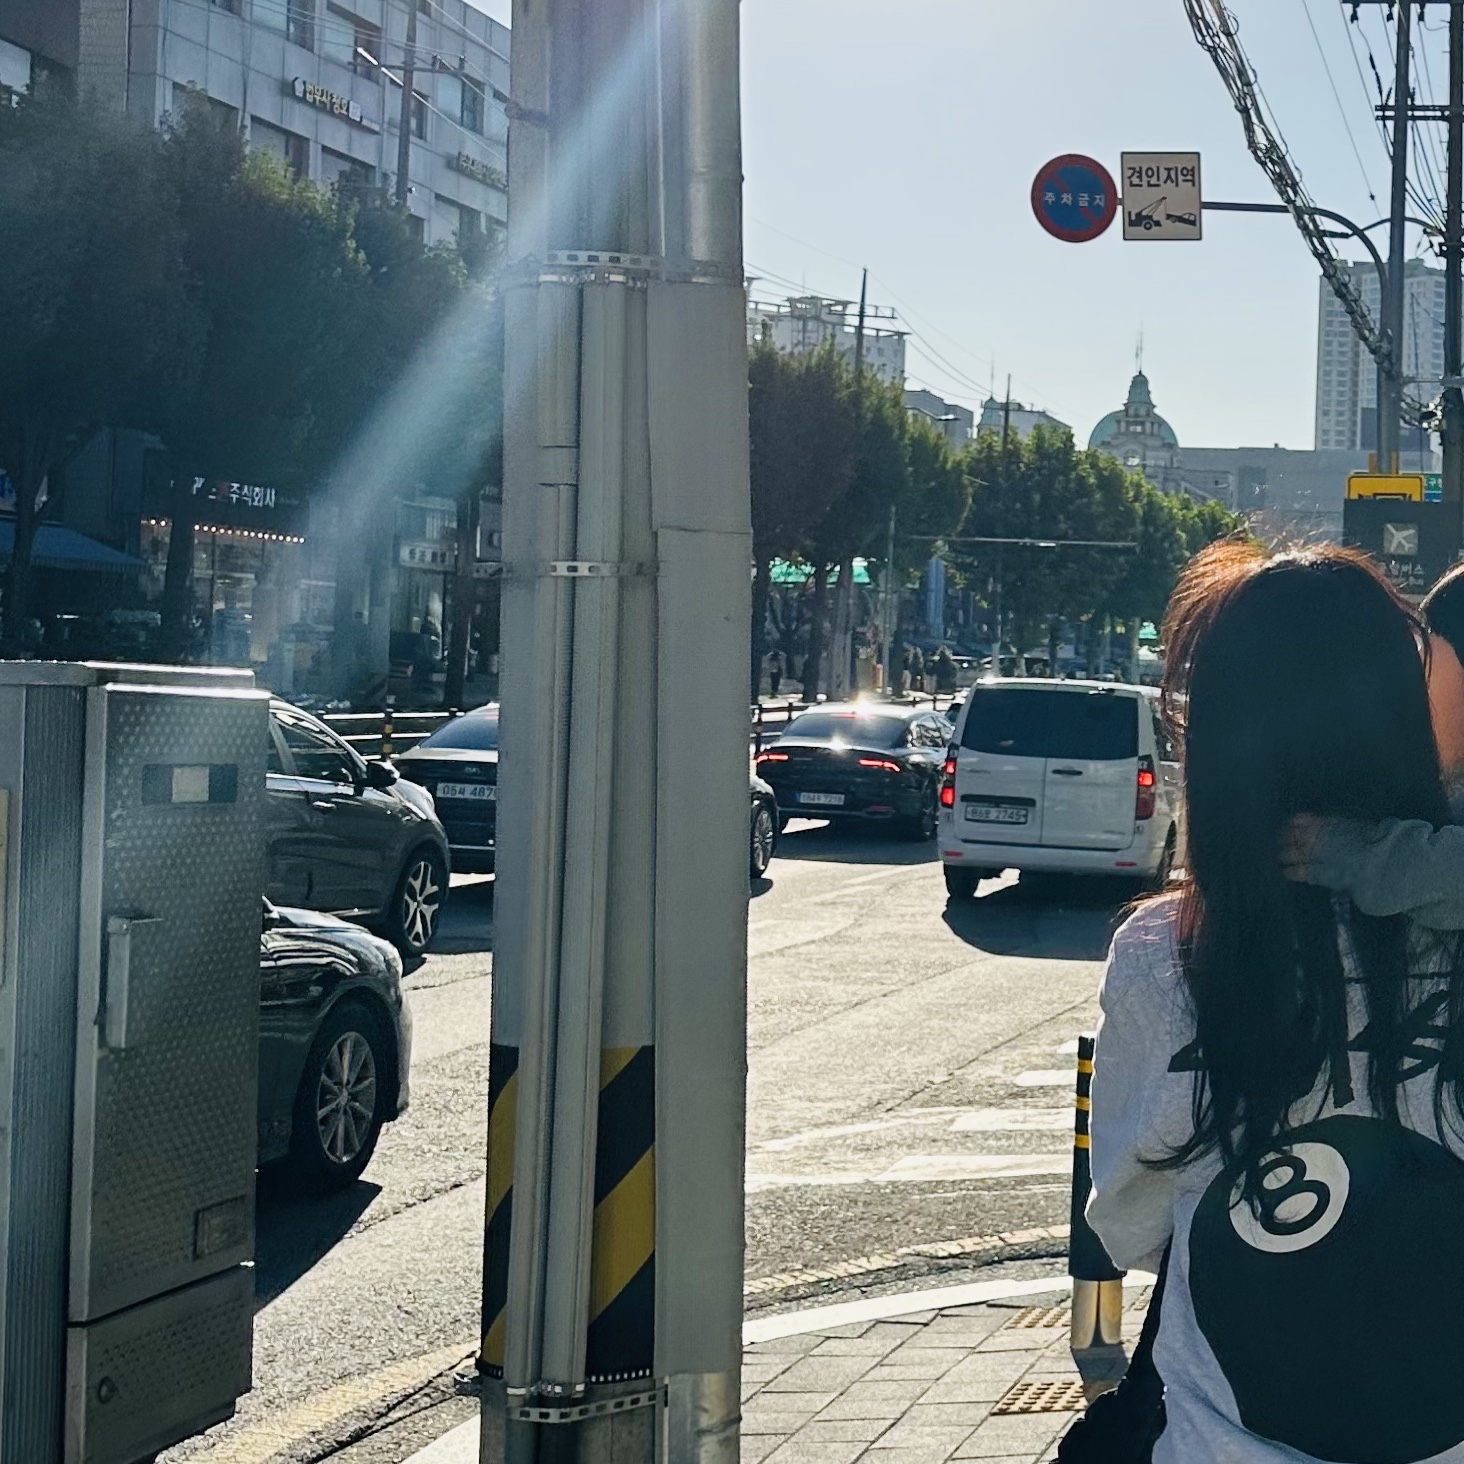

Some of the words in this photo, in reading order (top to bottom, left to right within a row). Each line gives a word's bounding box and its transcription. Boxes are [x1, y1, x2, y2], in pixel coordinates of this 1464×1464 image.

[1127, 166, 1196, 188] 견인지역
[229, 483, 276, 508] 주식회사
[1258, 1156, 1330, 1236] 8
